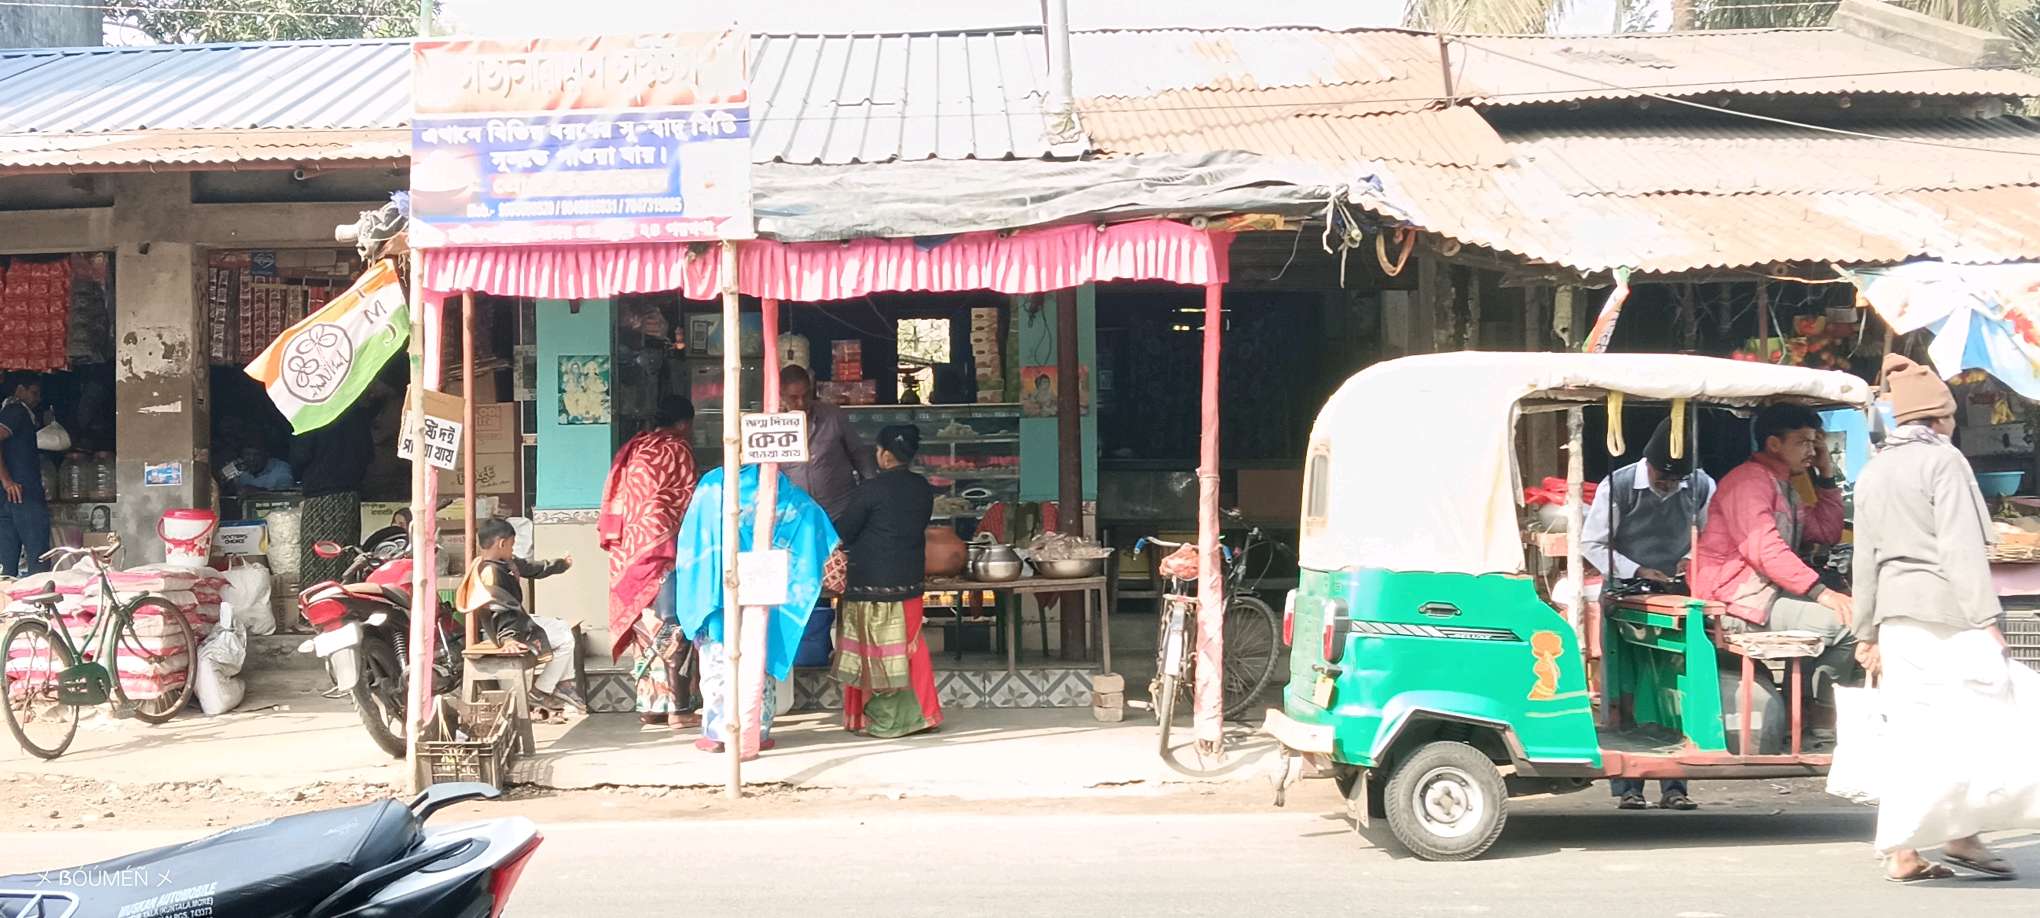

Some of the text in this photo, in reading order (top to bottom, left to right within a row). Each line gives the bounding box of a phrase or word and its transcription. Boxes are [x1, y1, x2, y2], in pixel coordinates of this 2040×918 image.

[439, 426, 456, 444] দই
[748, 431, 799, 448] কেক
[434, 445, 455, 466] যায়
[156, 881, 218, 908] AUTOMOBILE
